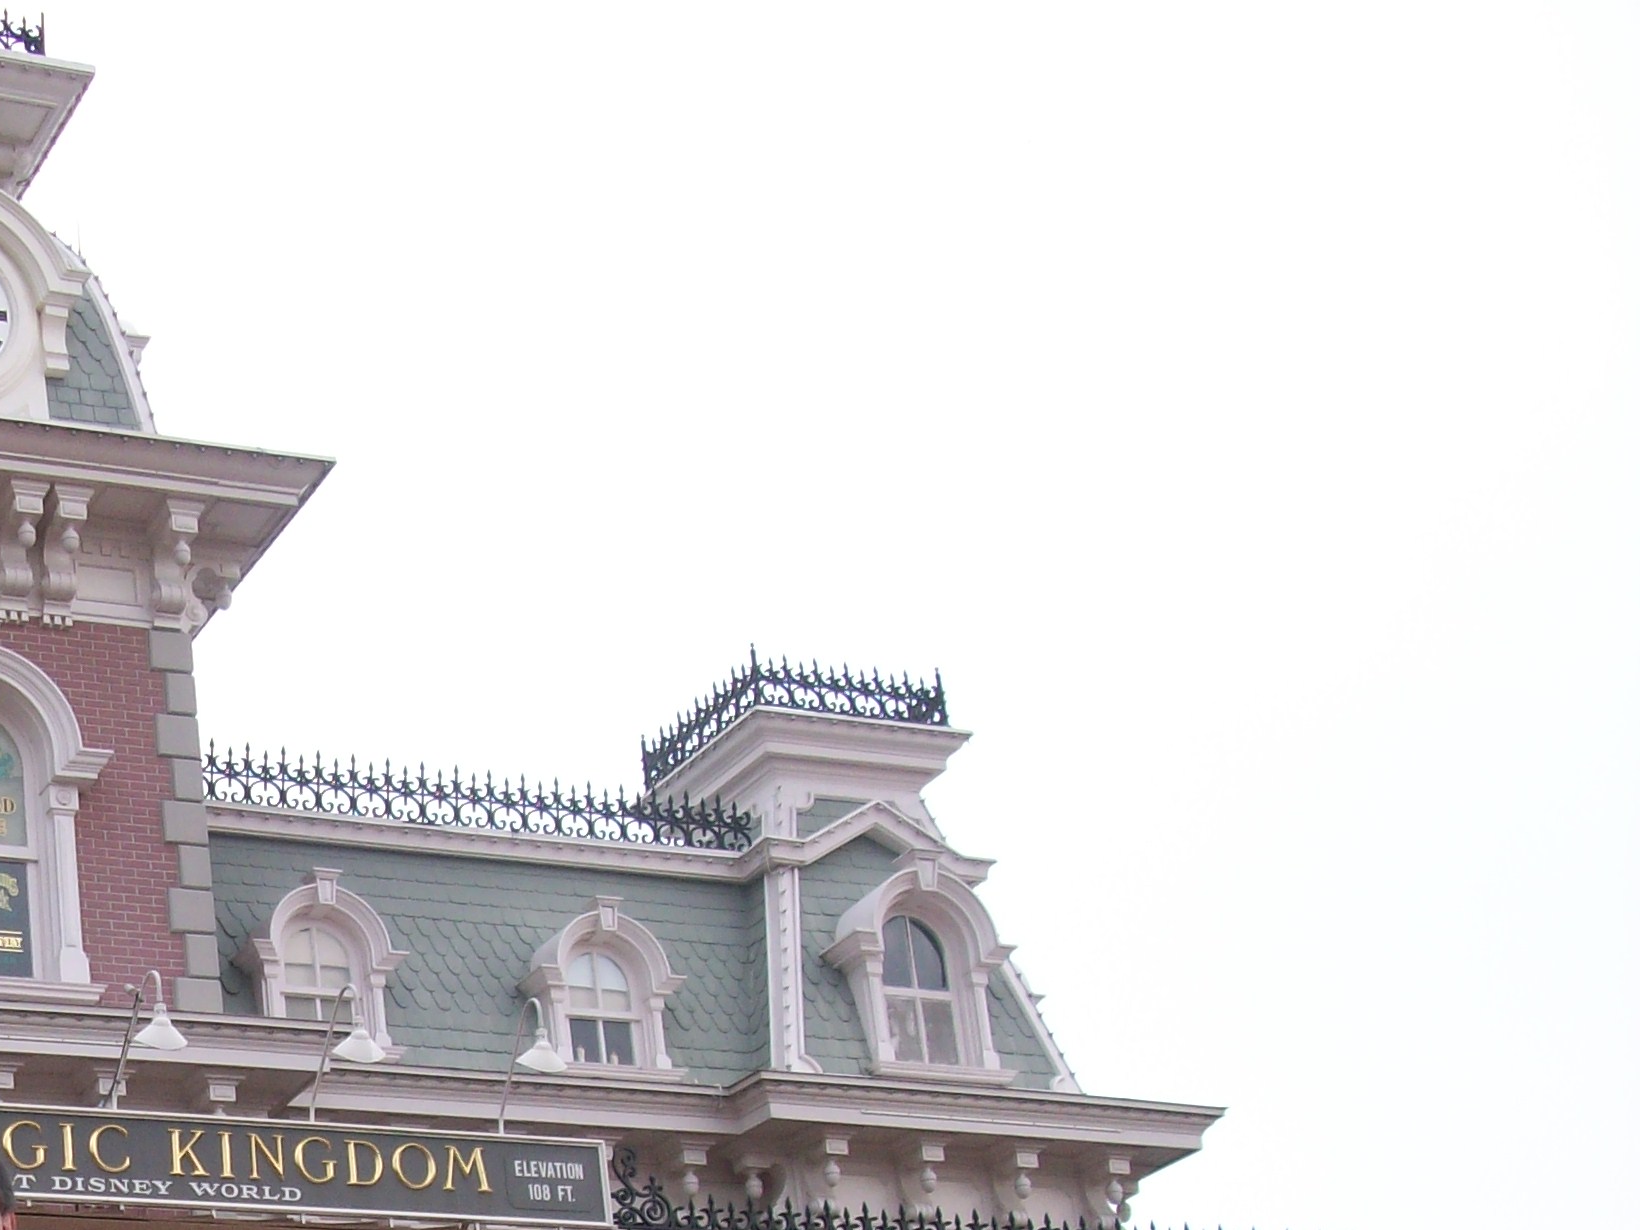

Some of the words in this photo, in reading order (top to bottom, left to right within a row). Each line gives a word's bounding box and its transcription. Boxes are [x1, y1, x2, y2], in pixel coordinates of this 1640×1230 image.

[168, 1126, 493, 1194] KINGDOM
[514, 1158, 585, 1181] ELEVATION
[51, 1175, 174, 1198] DISNEY
[189, 1181, 303, 1202] WORLD
[527, 1183, 551, 1202] 108
[557, 1184, 576, 1203] FT.
